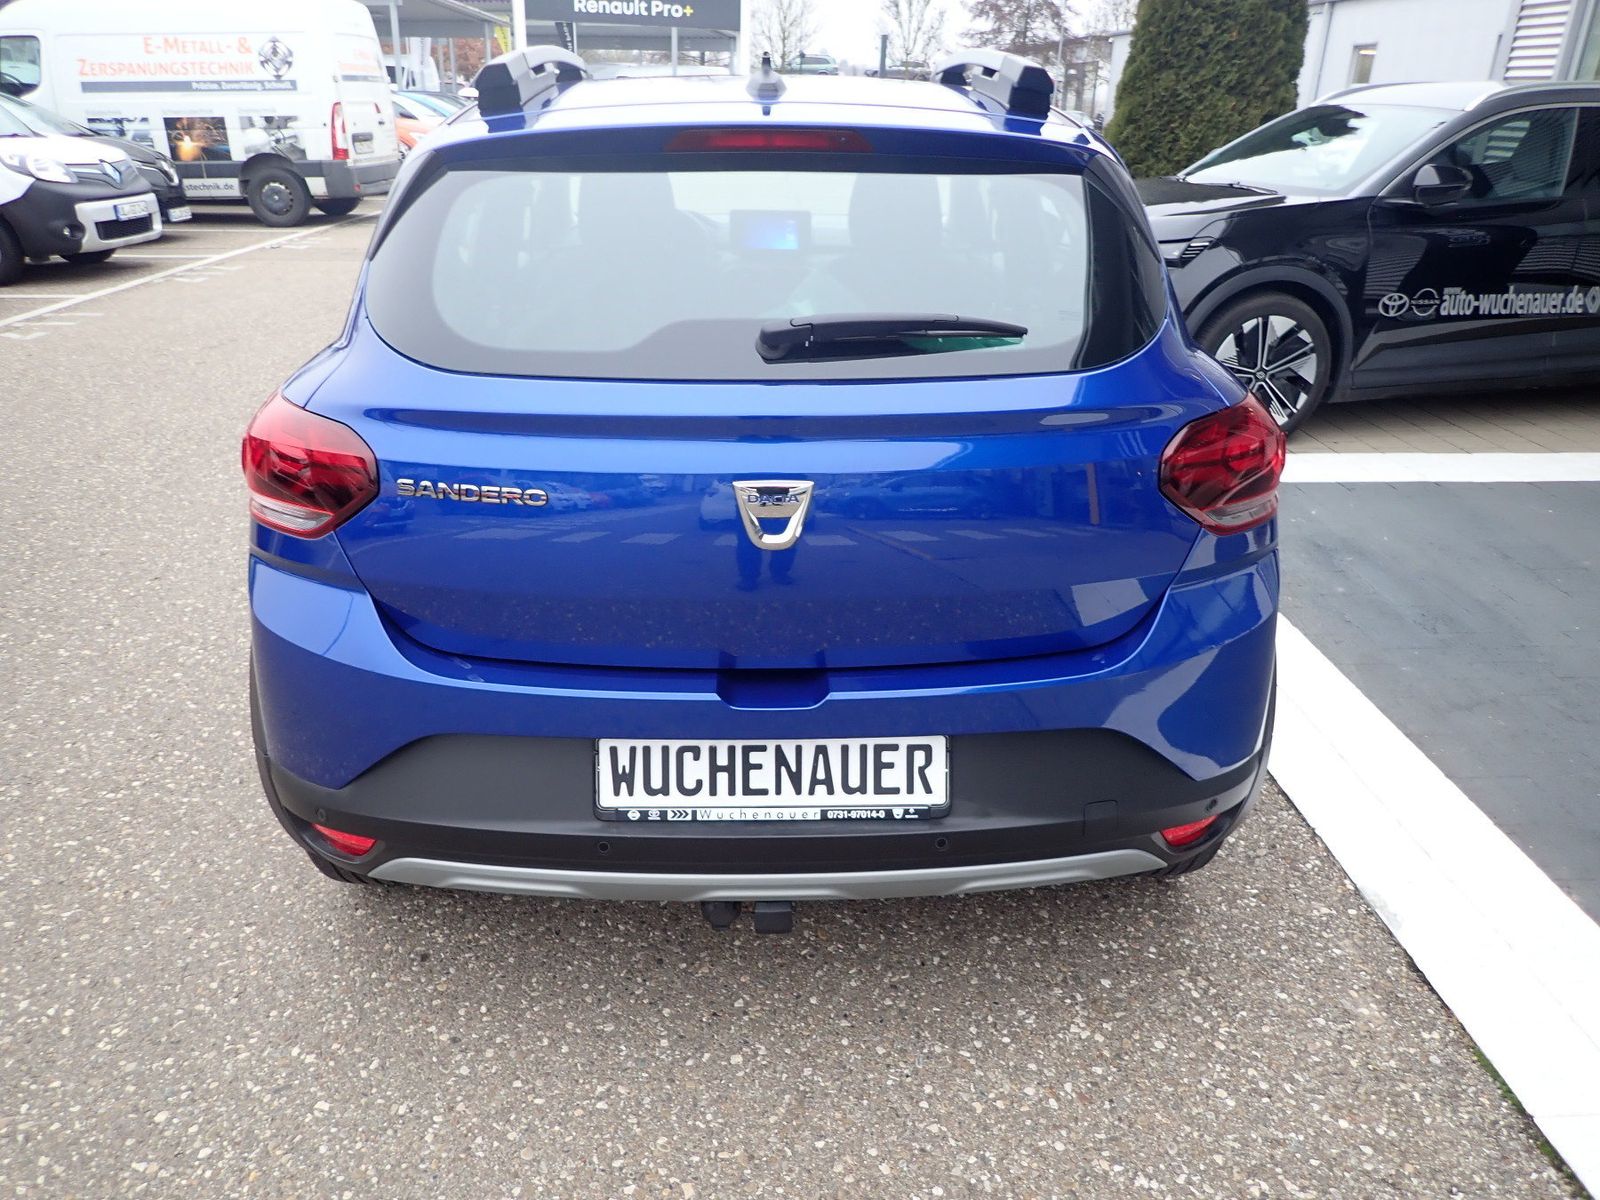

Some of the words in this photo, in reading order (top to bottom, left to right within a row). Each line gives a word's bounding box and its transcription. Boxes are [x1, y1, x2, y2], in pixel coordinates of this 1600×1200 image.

[574, 0, 648, 16] Renault
[651, 0, 694, 18] Pro+
[237, 37, 253, 55] &
[77, 58, 255, 77] ZERSPANUNGSTECHNIK
[1440, 285, 1584, 316] auto-wuchenauer.de
[396, 478, 549, 507] SANDERO
[747, 494, 800, 504] DACIA
[608, 743, 934, 797] WUCHENAUER
[699, 809, 819, 820] Wuchenauer
[827, 810, 885, 819] 0731-97014-0
